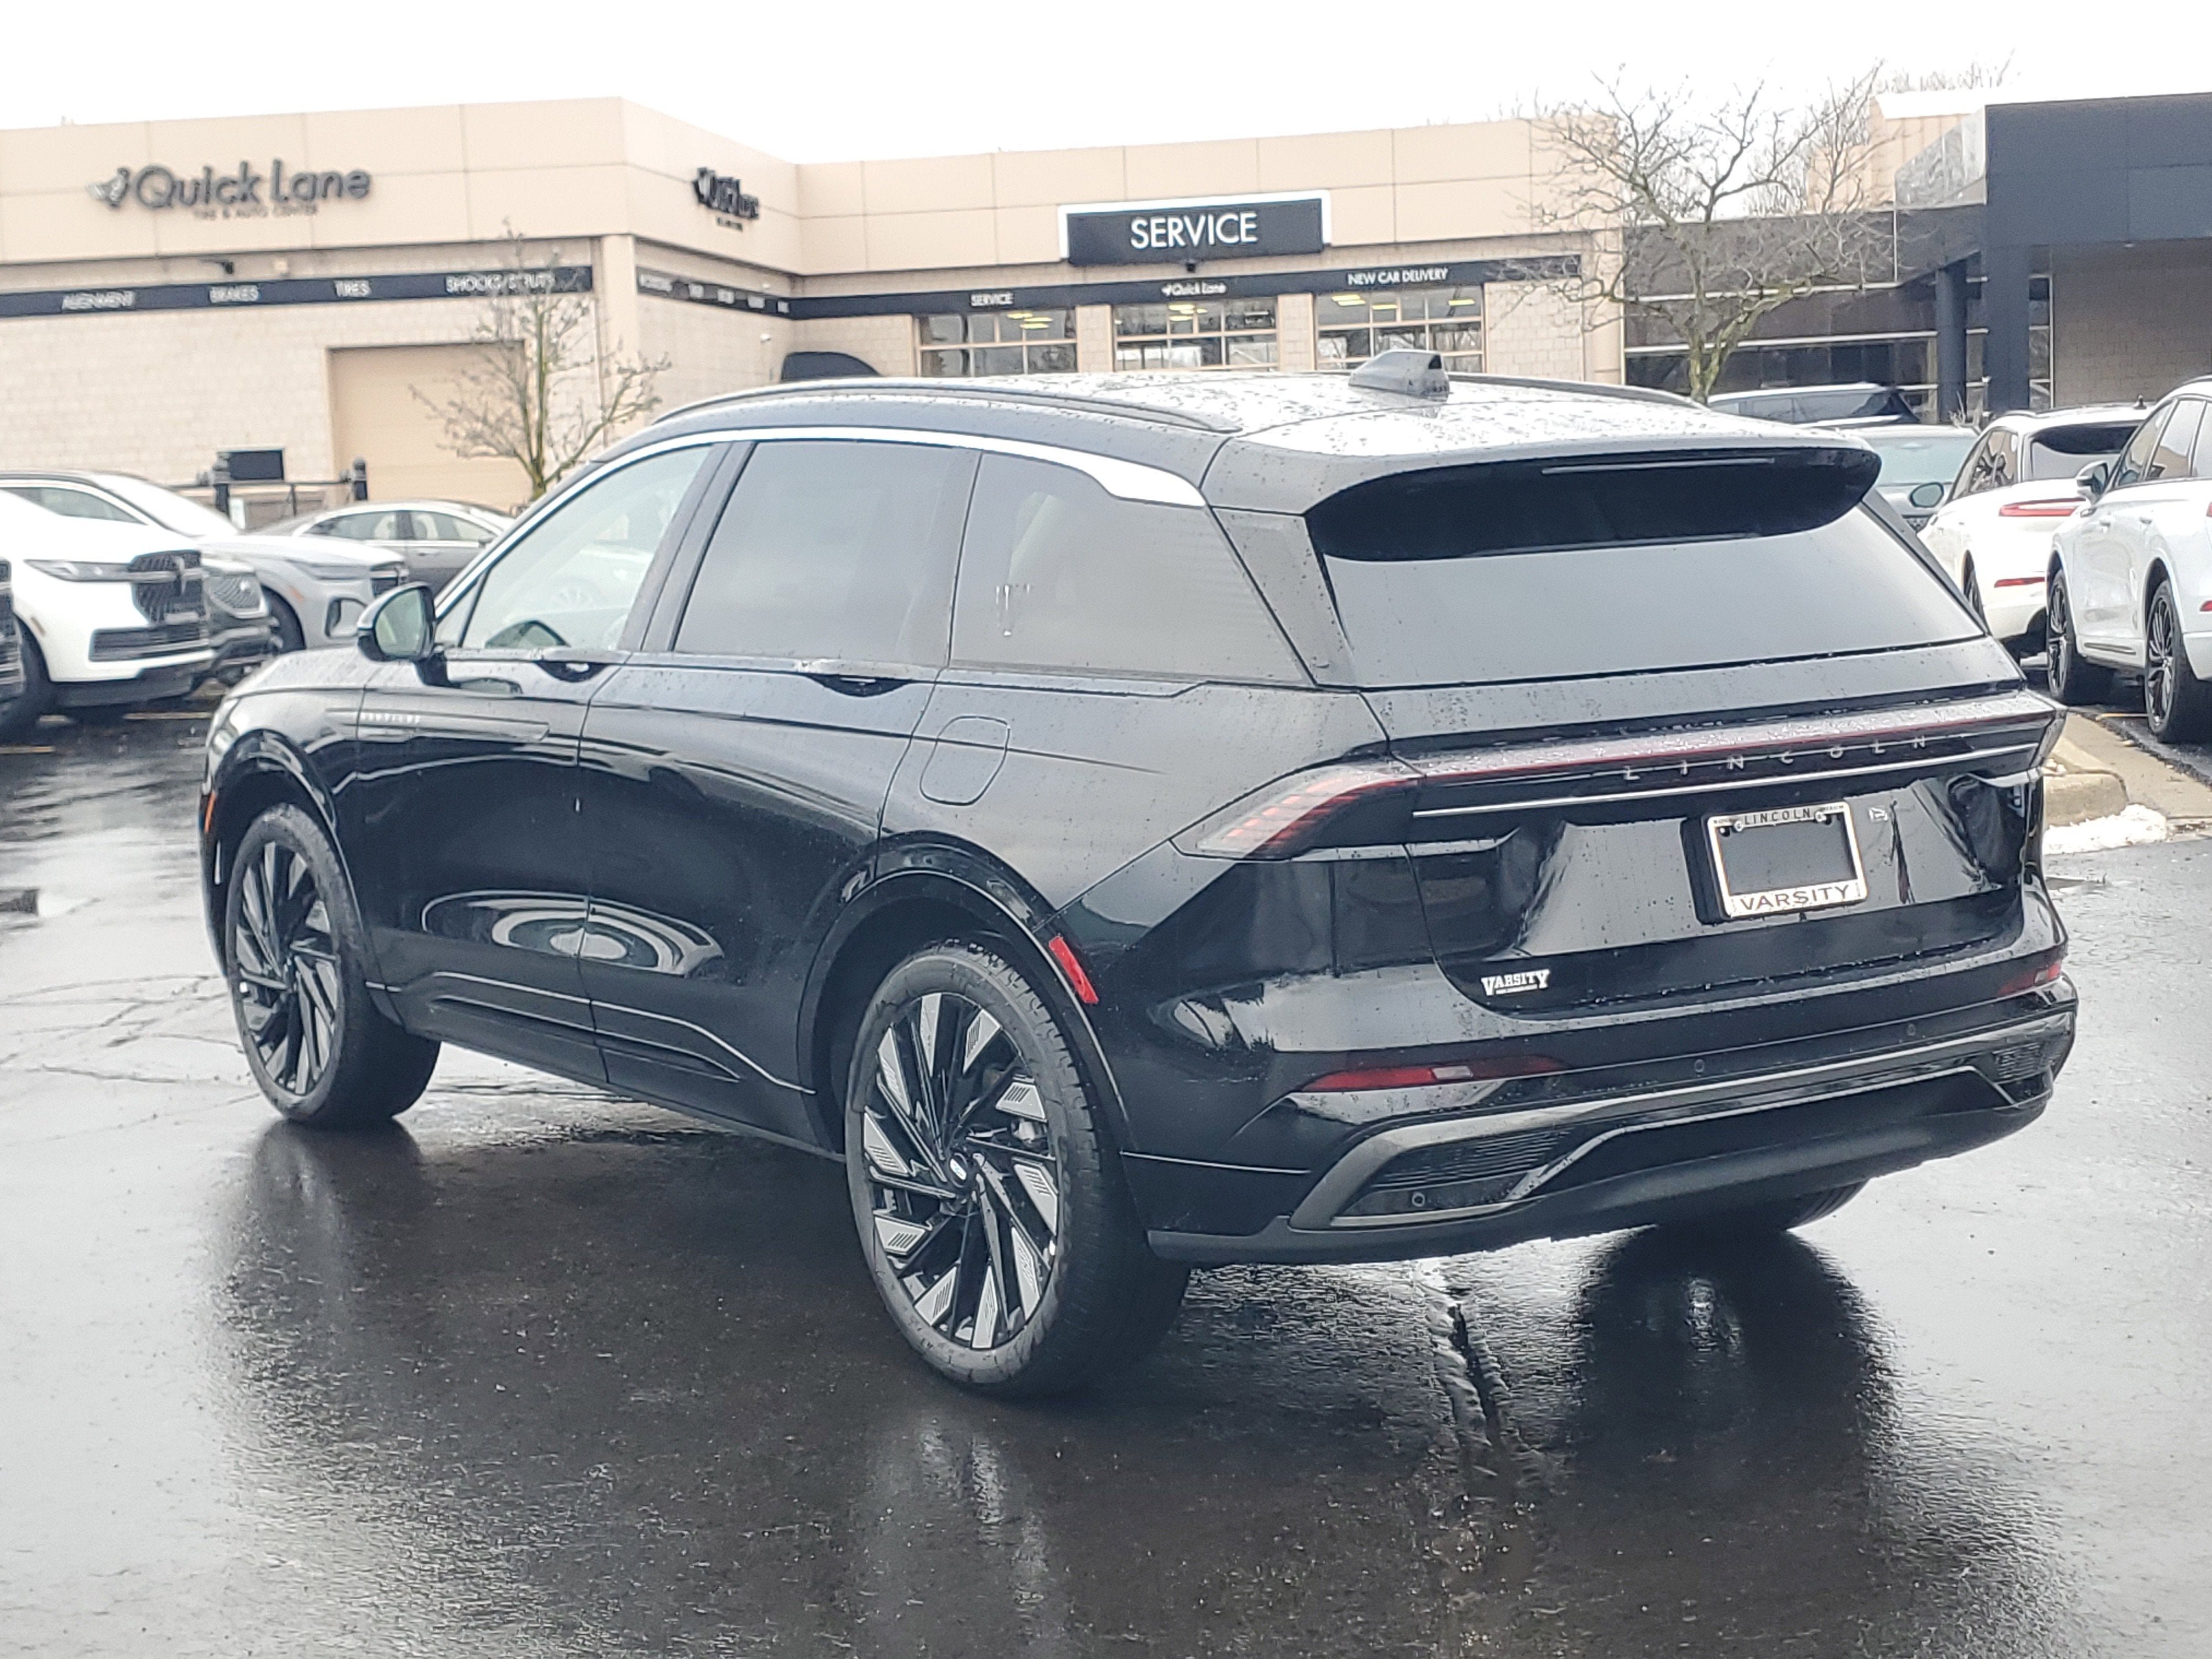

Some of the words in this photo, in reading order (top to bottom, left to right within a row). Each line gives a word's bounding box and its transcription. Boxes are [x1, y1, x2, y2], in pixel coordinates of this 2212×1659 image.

[135, 161, 261, 210] Quick
[271, 159, 371, 204] Lane
[1130, 212, 1259, 249] SERVICE
[1347, 273, 1376, 285] NEW
[1378, 270, 1400, 284] CAR
[1402, 266, 1448, 283] DELIVERY
[970, 291, 1014, 307] SERVICE
[1624, 735, 1926, 781] LINCOLN
[1745, 808, 1810, 825] LINCOLN
[1739, 884, 1850, 911] VARSITY
[1481, 968, 1551, 996] VARSITY
